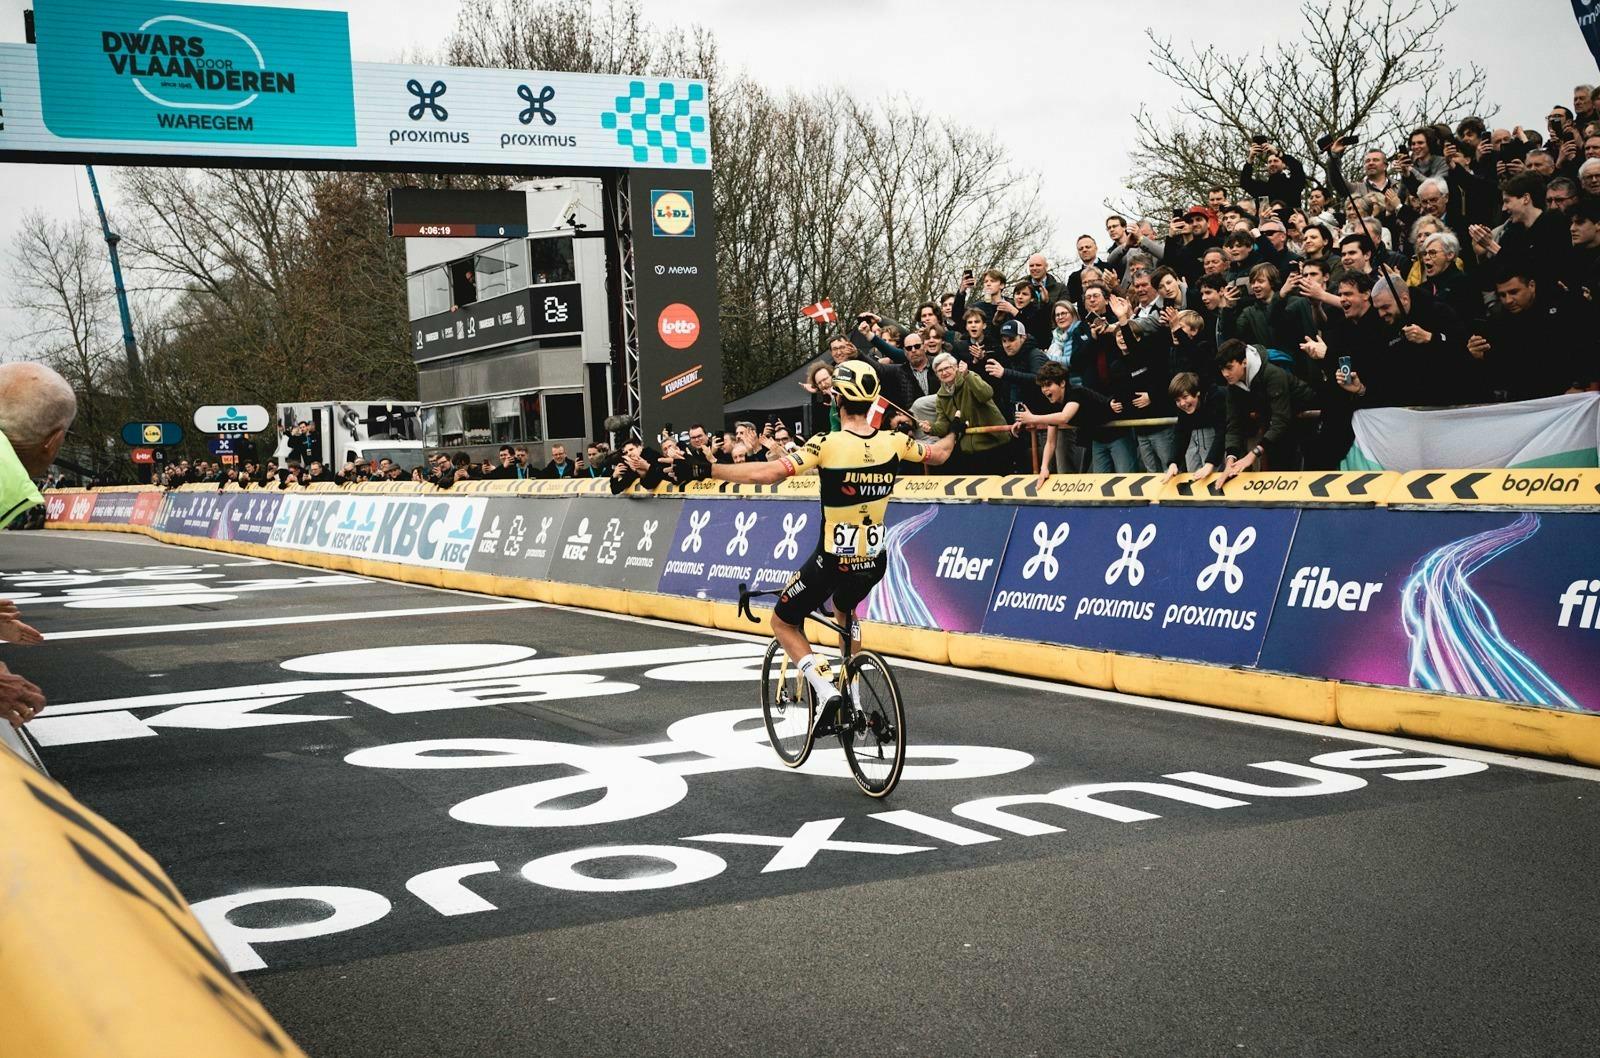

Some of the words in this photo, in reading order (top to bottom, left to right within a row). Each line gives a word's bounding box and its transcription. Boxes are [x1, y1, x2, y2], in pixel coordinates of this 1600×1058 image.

[101, 31, 205, 58] DWARS
[108, 53, 296, 93] VLAANDEREN
[197, 58, 233, 69] DOOR
[157, 113, 253, 131] WAREGEM
[389, 128, 470, 144] proximus
[500, 131, 577, 148] proximus
[419, 226, 451, 235] 4:06:19
[217, 422, 248, 431] KBC
[787, 480, 816, 490] boplan
[842, 472, 894, 484] JUMBO
[905, 480, 939, 492] boplan
[1051, 479, 1093, 495] boplan
[1501, 473, 1579, 496] boplan
[287, 500, 341, 547] KBC
[372, 502, 450, 560] KBC
[331, 532, 351, 549] KBC
[350, 535, 370, 552] KBC
[833, 524, 860, 546] 67
[866, 525, 886, 547] 6
[440, 543, 470, 564] KBC
[478, 539, 499, 553] KBC
[562, 544, 589, 561] KBC
[624, 556, 654, 568] proximus
[664, 559, 704, 577] proximus
[707, 564, 751, 581] proximus
[935, 546, 995, 580] fiber
[1288, 566, 1383, 612] fiber
[994, 589, 1067, 612] proximus
[1074, 596, 1155, 622] proximus
[1162, 603, 1257, 631] proximus
[187, 745, 1489, 973] proximus
